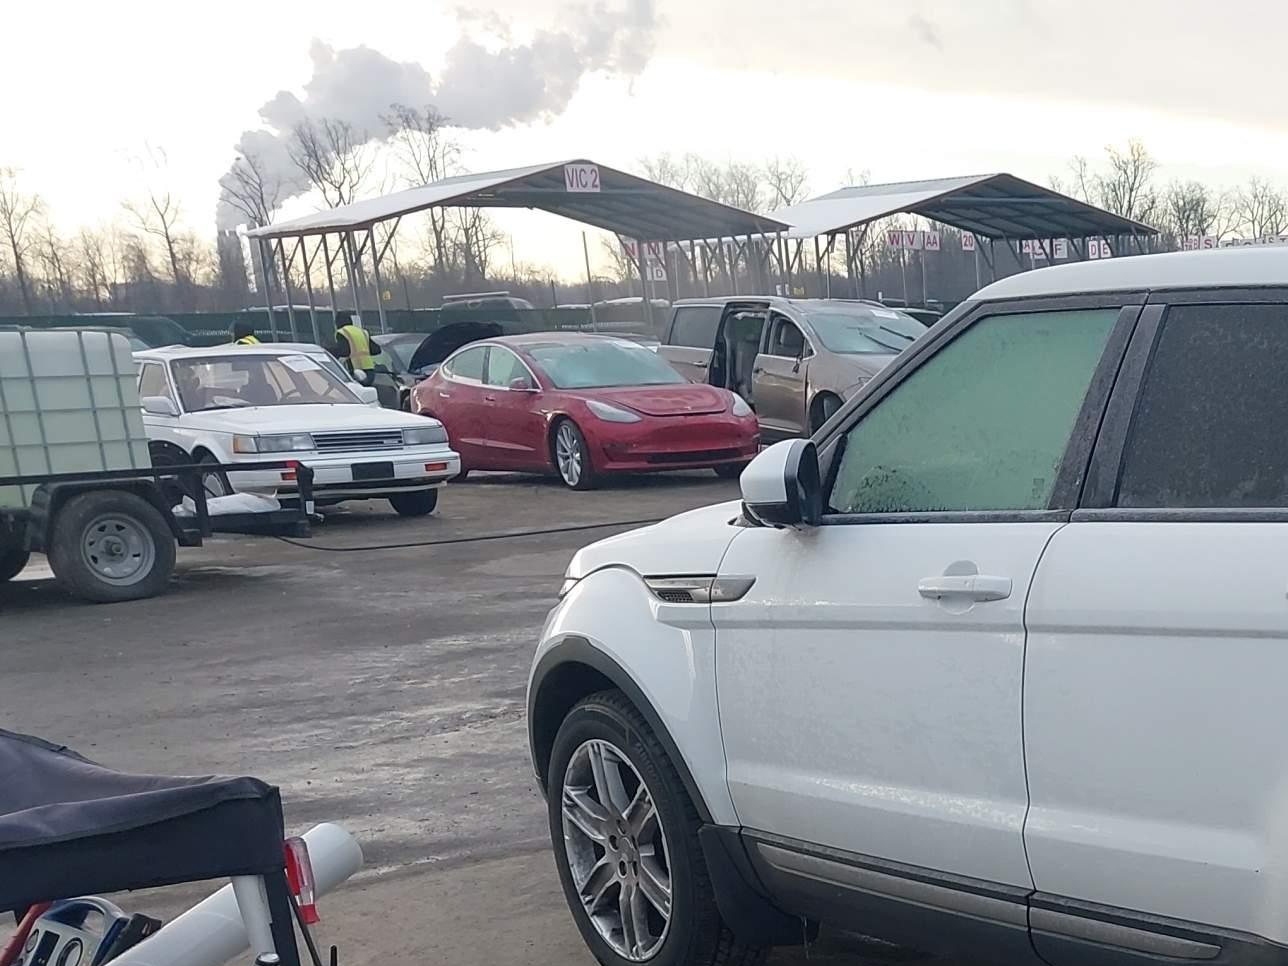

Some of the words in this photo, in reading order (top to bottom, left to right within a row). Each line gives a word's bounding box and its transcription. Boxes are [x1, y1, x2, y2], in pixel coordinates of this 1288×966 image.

[566, 168, 588, 189] VIC
[591, 168, 599, 189] 2
[888, 233, 900, 247] W
[906, 233, 915, 246] V
[926, 235, 938, 247] AA
[962, 234, 974, 247] 20
